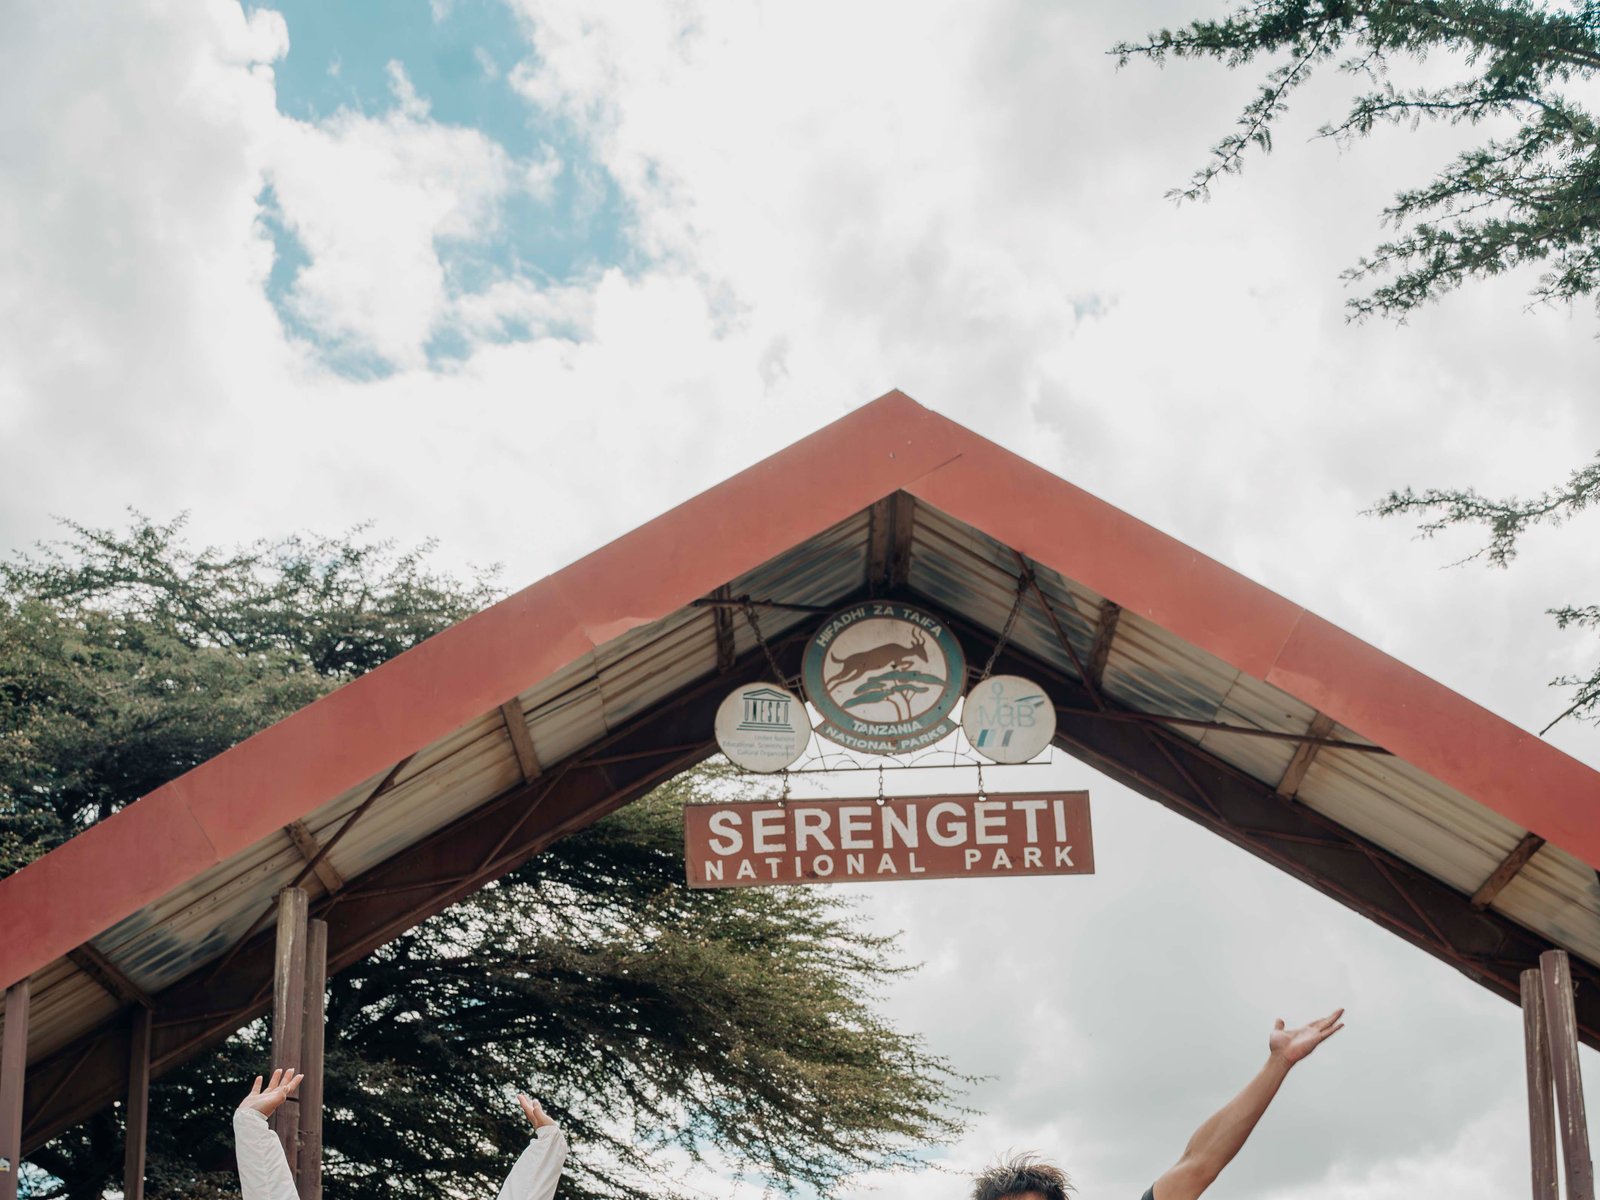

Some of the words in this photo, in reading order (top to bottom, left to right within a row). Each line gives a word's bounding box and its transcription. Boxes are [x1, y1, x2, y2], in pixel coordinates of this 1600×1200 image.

[816, 607, 866, 647] HIFADHI
[873, 605, 894, 616] ZA
[903, 609, 943, 638] TAIFA
[744, 700, 788, 723] UNESCO
[826, 726, 897, 750] NATIONAL
[901, 725, 947, 749] PARKS
[853, 720, 923, 736] TANZANIA
[708, 800, 1067, 856] SERENGETI
[705, 852, 925, 881] NATIONAL
[965, 846, 1074, 870] PARK
